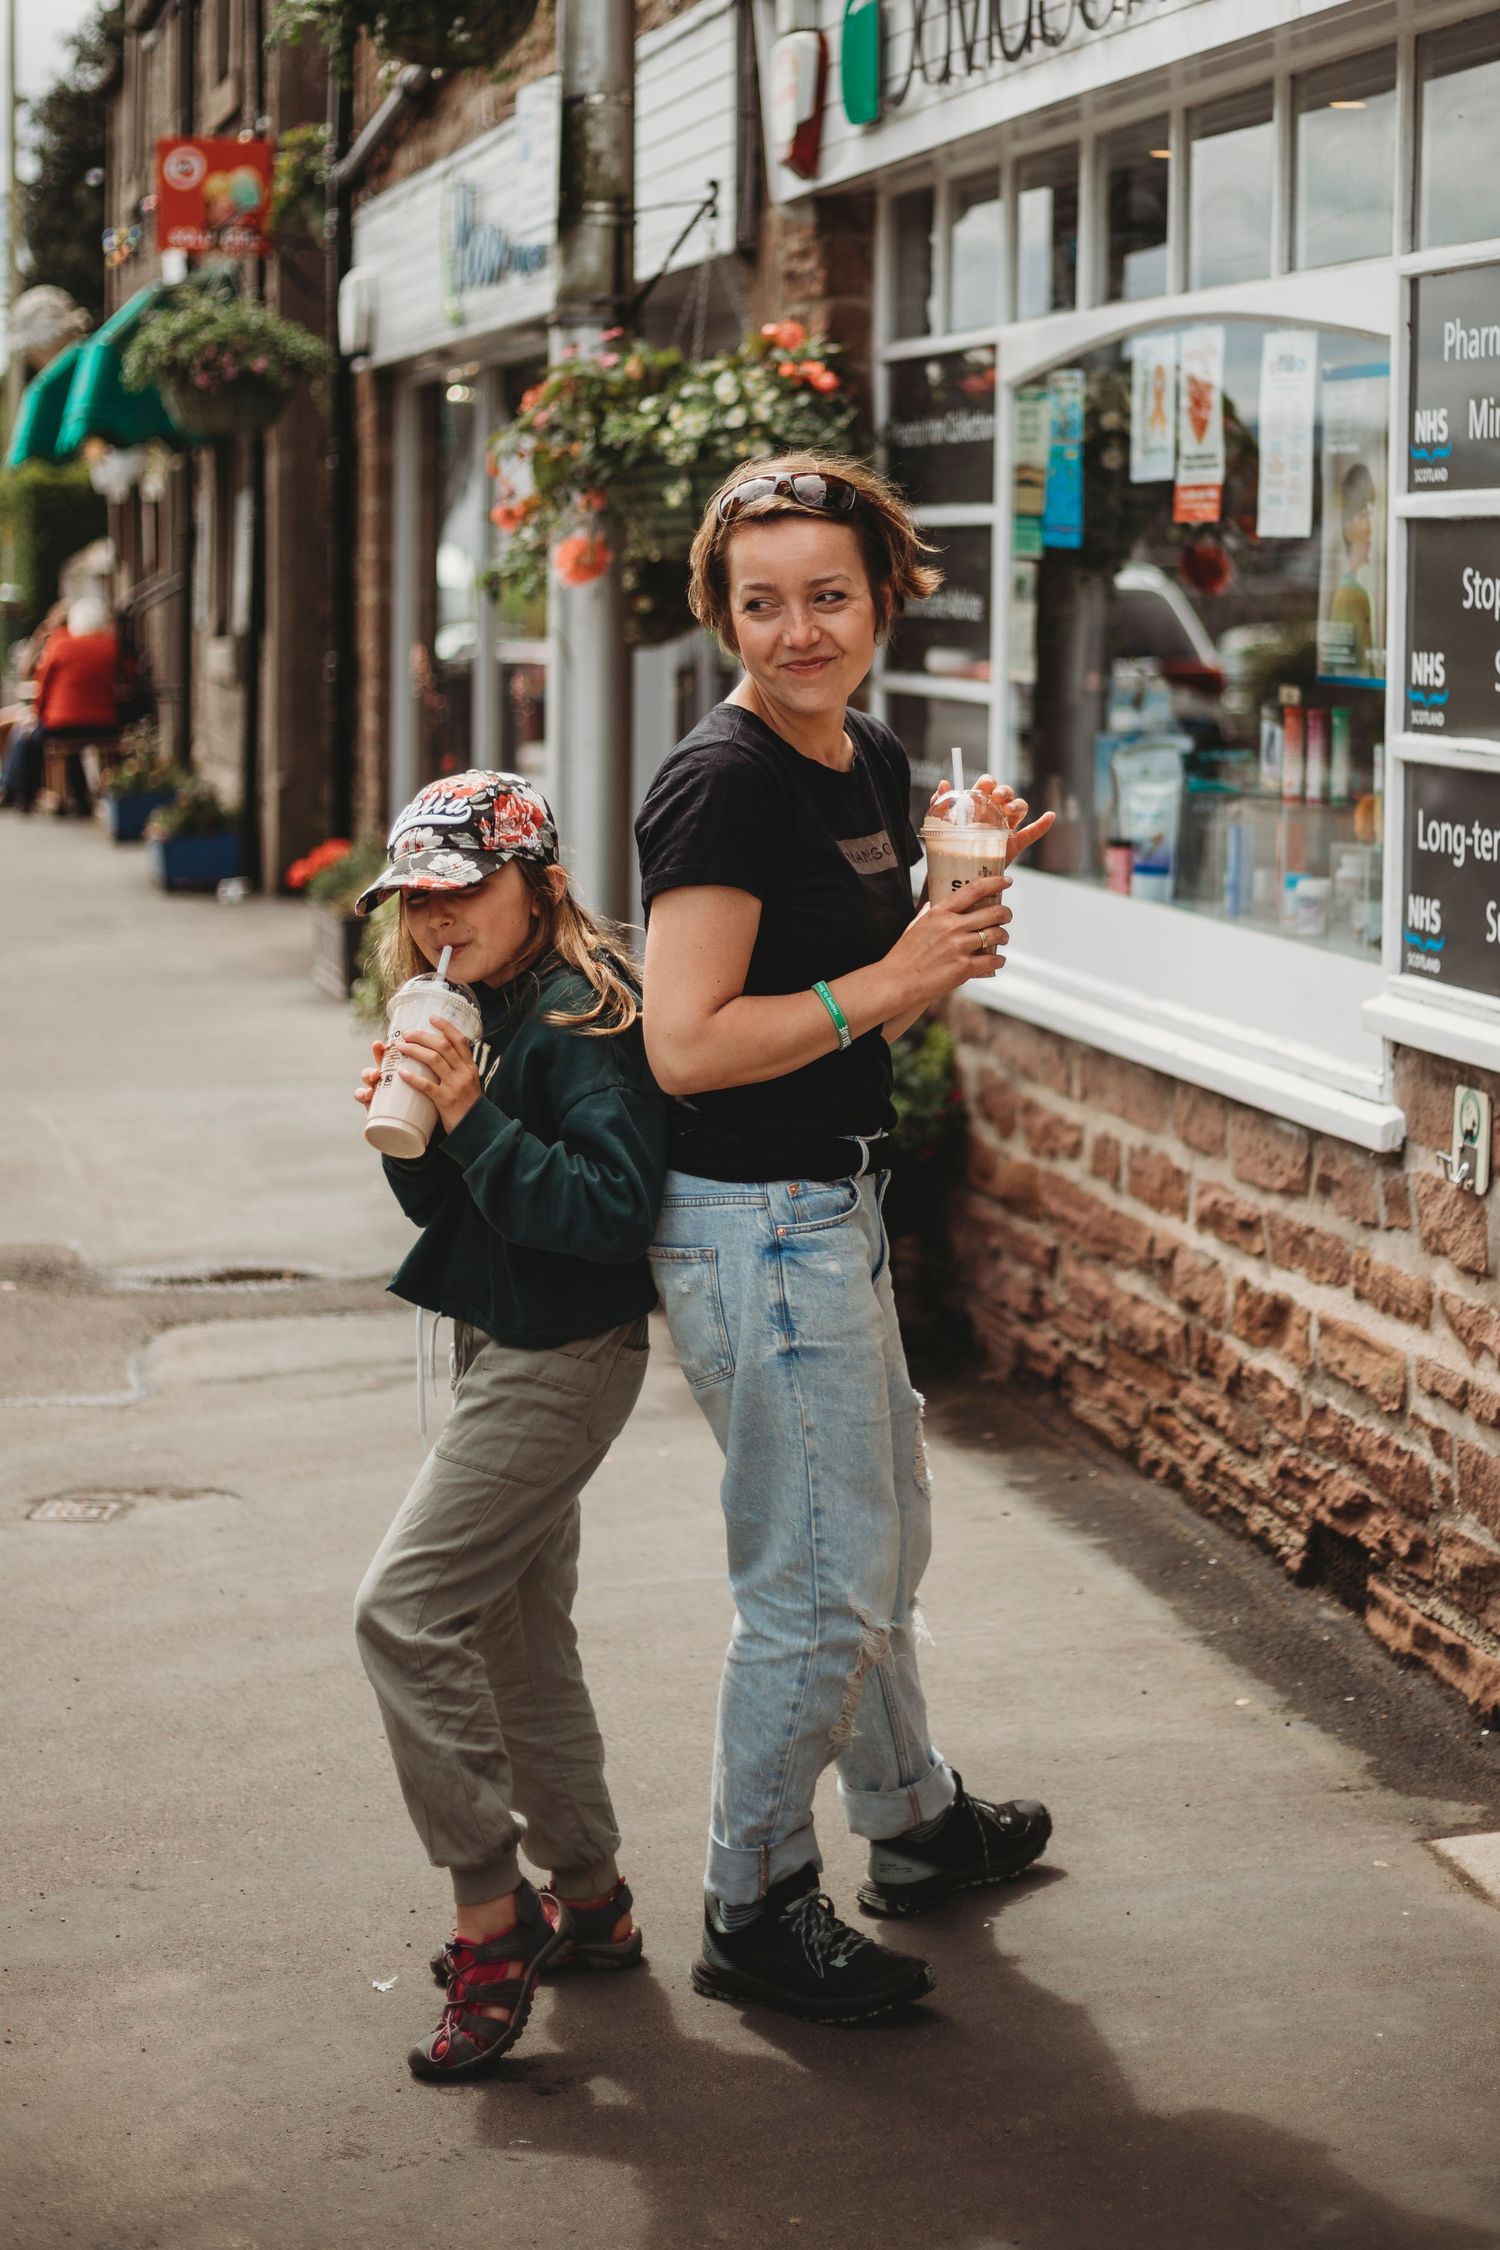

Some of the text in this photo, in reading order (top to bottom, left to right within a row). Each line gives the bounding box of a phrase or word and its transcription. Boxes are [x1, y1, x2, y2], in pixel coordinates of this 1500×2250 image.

[1414, 407, 1449, 444] NHS
[1414, 467, 1449, 483] SCOTLAND
[1411, 651, 1446, 688] NHS
[1411, 709, 1445, 727] SCOTLAND
[1408, 894, 1442, 935] NHS
[1486, 900, 1500, 944] S
[1407, 951, 1441, 974] SCOTLAND
